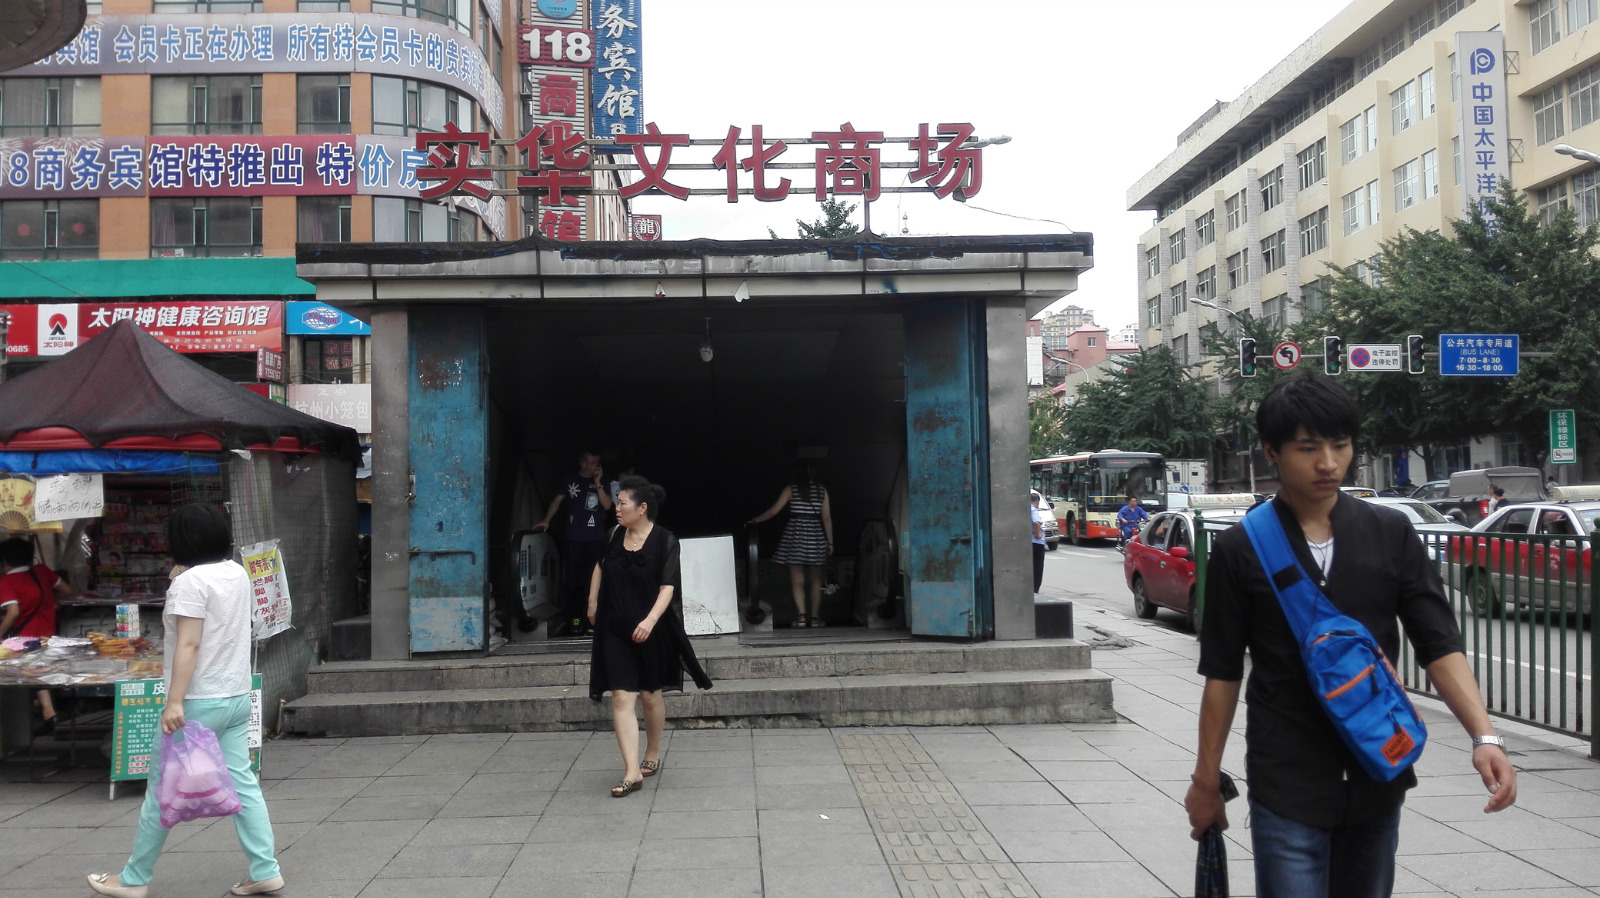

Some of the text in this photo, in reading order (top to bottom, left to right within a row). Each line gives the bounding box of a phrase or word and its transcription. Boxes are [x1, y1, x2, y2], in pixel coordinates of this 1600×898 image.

[113, 24, 274, 63] 会员卡正在办理
[522, 28, 592, 62] 118
[415, 121, 983, 202] 实华文化商场
[88, 305, 270, 328] 太阳神健康咨询馆
[1446, 338, 1513, 348] 公共汽车专用道
[1371, 358, 1398, 366] 违停处罚
[294, 400, 370, 420] 杭州小笼包
